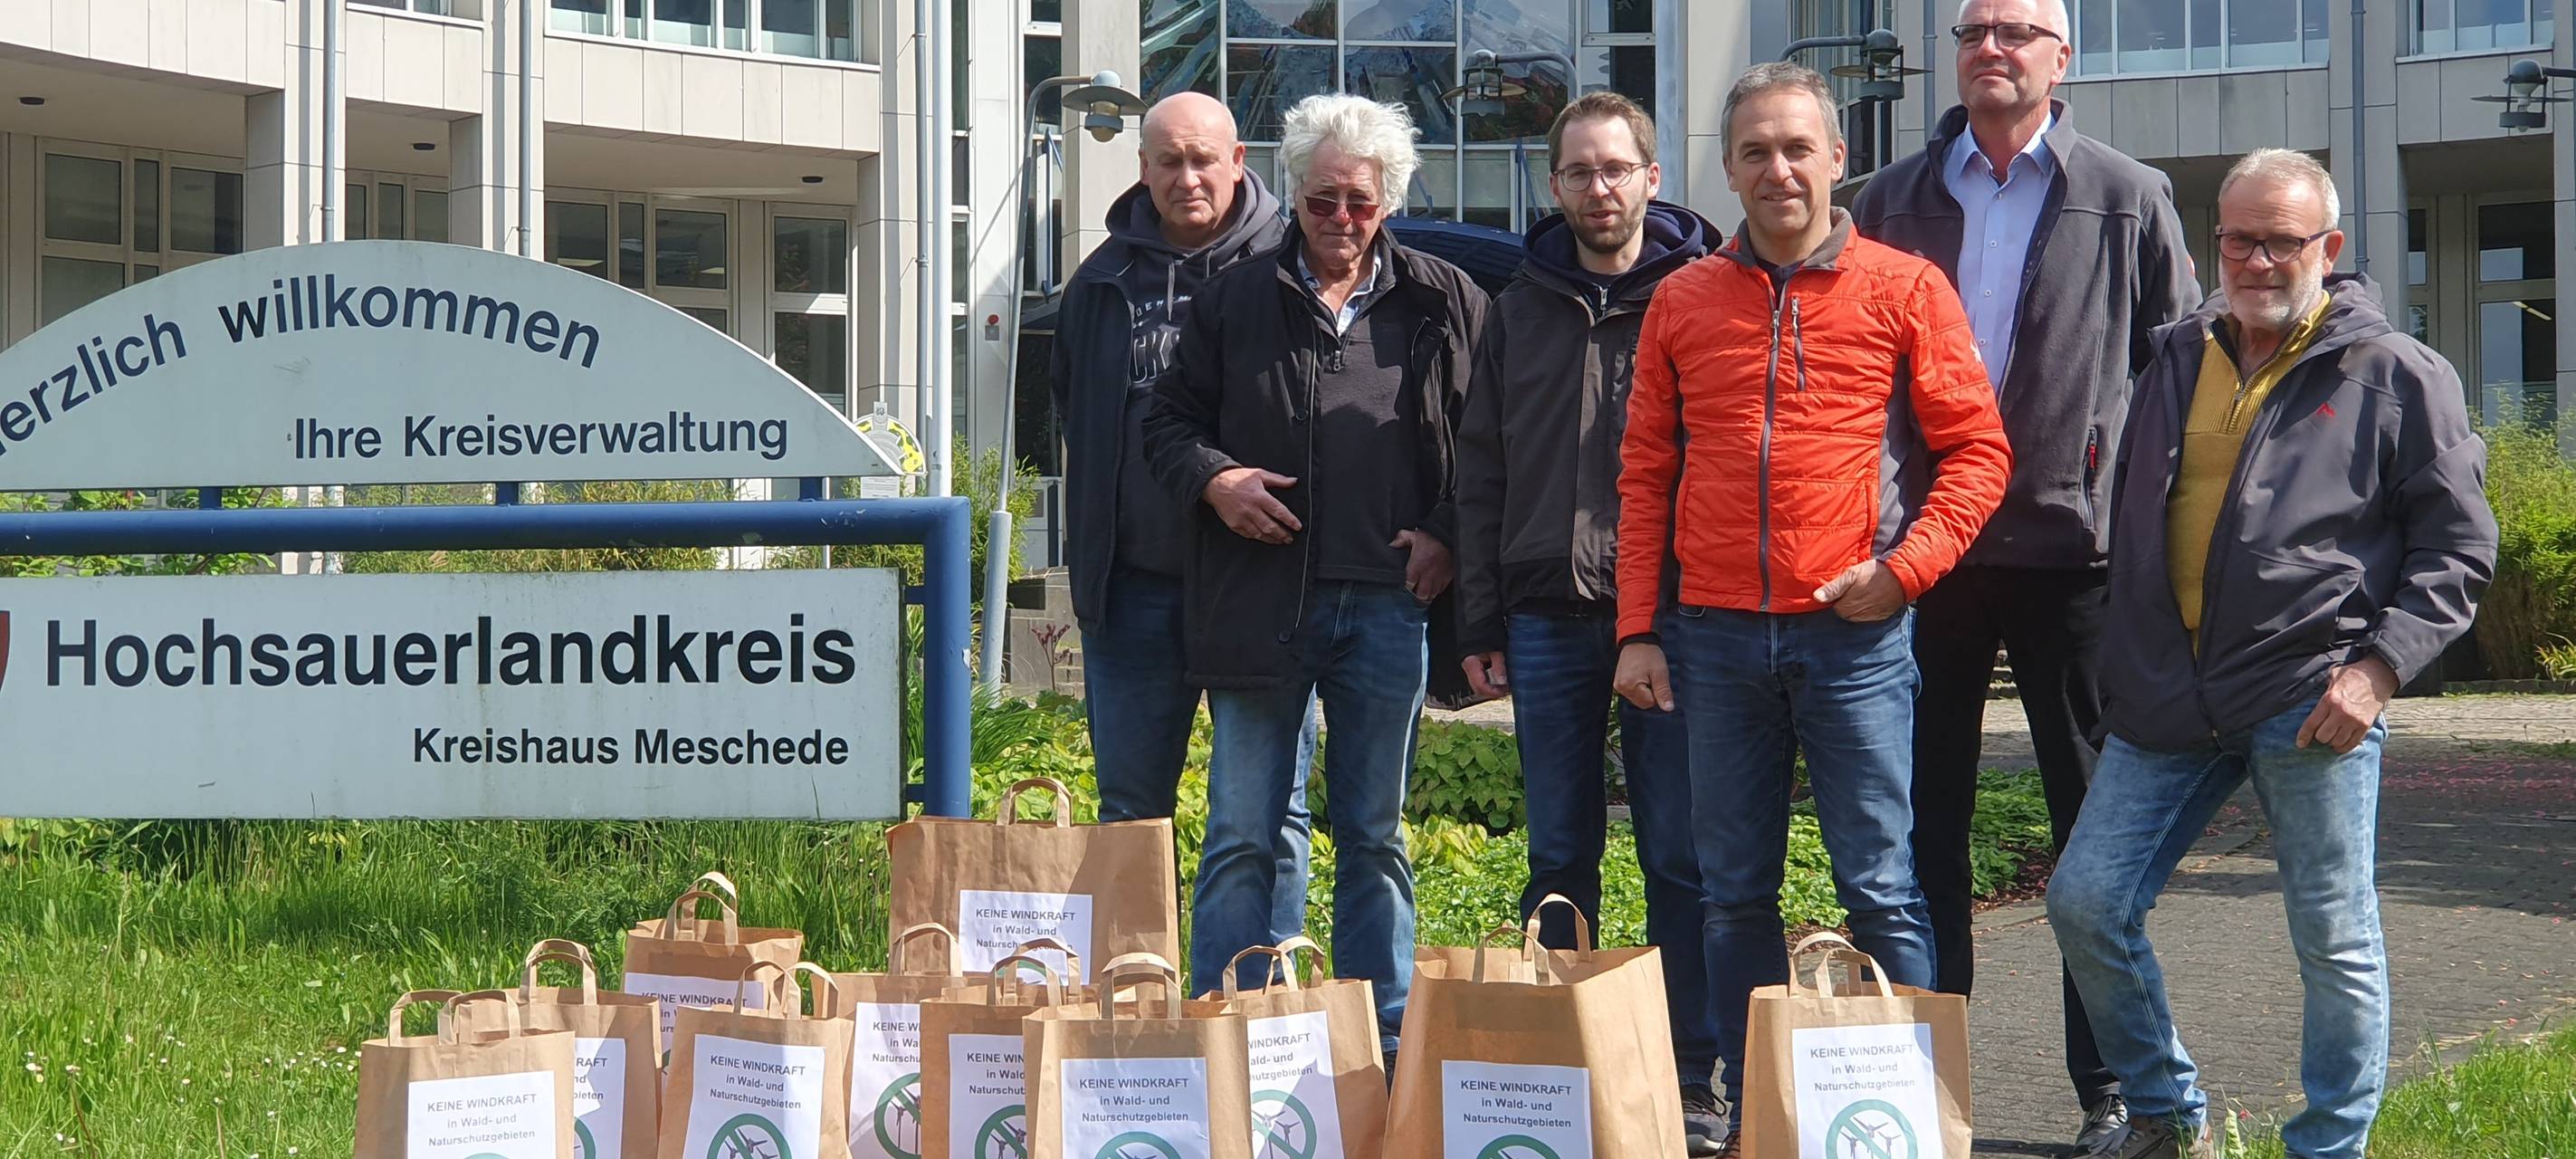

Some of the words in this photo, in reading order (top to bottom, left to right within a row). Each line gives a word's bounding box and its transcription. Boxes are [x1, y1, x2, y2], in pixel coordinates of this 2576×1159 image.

[218, 273, 600, 369] willkommen
[297, 418, 381, 458] Ihre
[405, 412, 787, 460] Kreisverwaltung
[48, 614, 854, 686] Hochsauerlandkreis
[415, 728, 618, 763] Kreishaus
[635, 729, 848, 764] Meschede
[976, 908, 1008, 919] KEINE
[1010, 910, 1076, 921] WINDKRAFT
[993, 924, 1002, 934] in
[1006, 925, 1034, 935] Wald-
[1037, 927, 1057, 935] und
[679, 994, 748, 1007] WINDKRAT
[873, 1021, 905, 1031] KEINE
[890, 1038, 899, 1048] in
[967, 1052, 1001, 1063] KEINE
[1250, 1055, 1271, 1065] ald-
[1273, 1051, 1293, 1062] und
[1810, 1048, 1846, 1058] KEINE
[1848, 1044, 1913, 1057] WINDKRAFT
[711, 1055, 739, 1068] KEINE
[742, 1059, 806, 1076] WINDKRAFT
[1832, 1065, 1842, 1075] in
[1845, 1064, 1876, 1074] Wald-
[1878, 1062, 1898, 1073] und
[986, 1068, 997, 1079] in
[726, 1074, 735, 1084] in
[738, 1076, 763, 1088] Wald-
[766, 1082, 784, 1092] und
[1079, 1078, 1114, 1089] KEINE
[1118, 1078, 1188, 1088] WINDKRAFT
[1461, 1080, 1497, 1091] KEINE
[1500, 1083, 1571, 1096] WINDKRAFT
[1814, 1079, 1914, 1092] Naturschutzgebieten
[427, 1100, 463, 1113] KEINE
[467, 1093, 537, 1108] WINDKRAFT
[710, 1088, 801, 1109] Naturschutzgebieten
[1100, 1096, 1110, 1106] in
[1113, 1096, 1146, 1106] Wald-
[1149, 1095, 1170, 1106] und
[1481, 1097, 1492, 1107] in
[1495, 1098, 1528, 1109] Wald-
[1531, 1102, 1552, 1112] und
[447, 1119, 457, 1129] in
[461, 1116, 493, 1128] Wald-
[496, 1114, 517, 1125] und
[1082, 1112, 1188, 1124] Naturschutzgebieten
[1463, 1113, 1571, 1128] Naturschutzgebieten
[429, 1130, 536, 1146] Naturschutzgebieten
